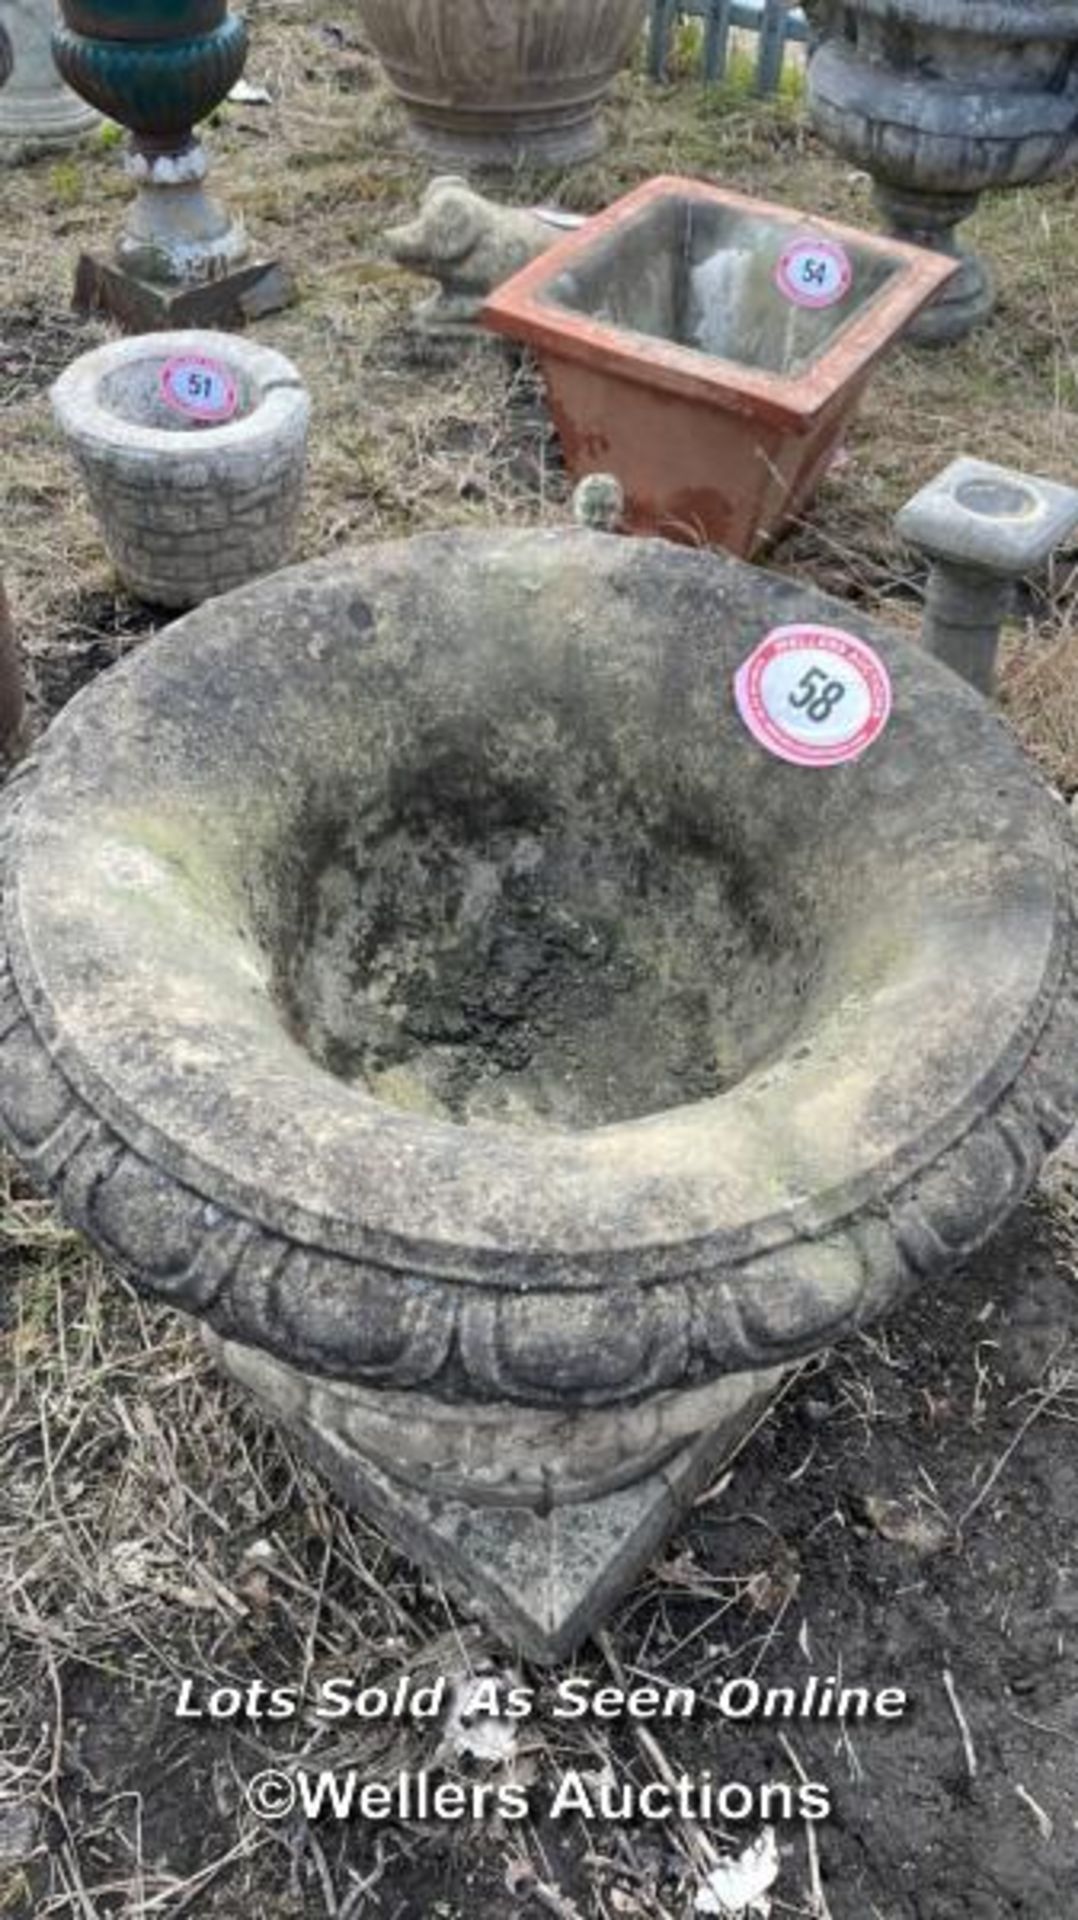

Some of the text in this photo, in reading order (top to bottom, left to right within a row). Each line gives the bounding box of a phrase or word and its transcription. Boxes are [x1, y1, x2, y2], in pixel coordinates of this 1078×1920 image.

[802, 258, 827, 286] 54
[188, 373, 212, 398] 51
[788, 666, 846, 723] 58
